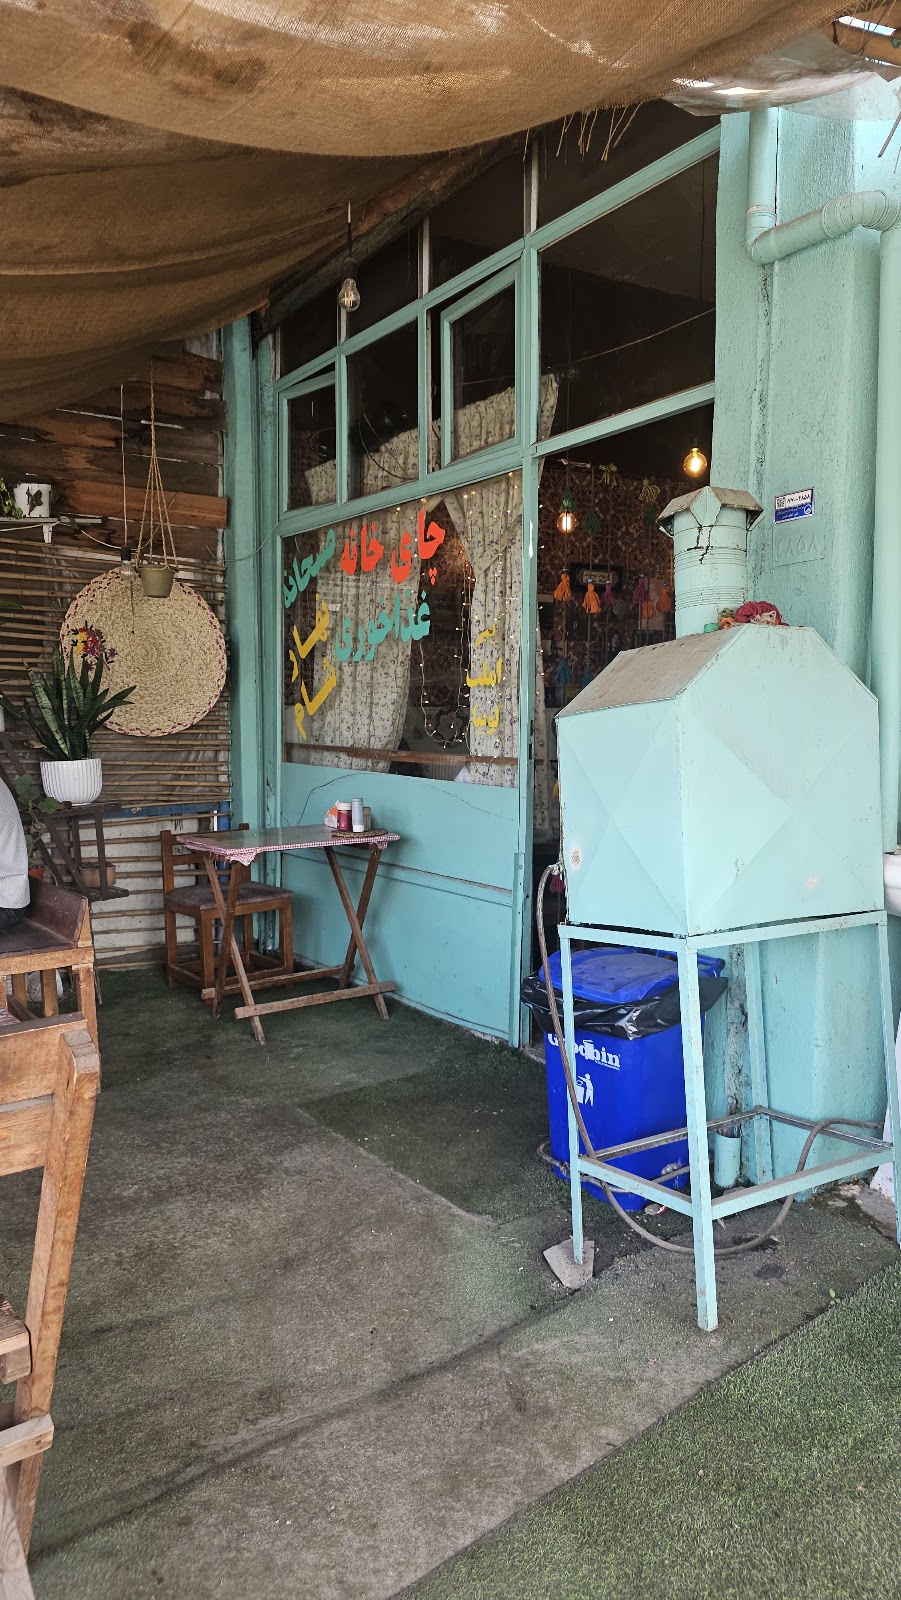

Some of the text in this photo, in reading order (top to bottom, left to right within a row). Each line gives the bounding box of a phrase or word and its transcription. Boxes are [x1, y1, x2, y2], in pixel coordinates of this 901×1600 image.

[283, 529, 336, 609] صبحانه
[340, 506, 446, 586] چای خانه
[289, 593, 330, 683] نهار
[466, 656, 503, 688] املت
[295, 657, 337, 741] شام
[473, 706, 500, 735] لوبیا
